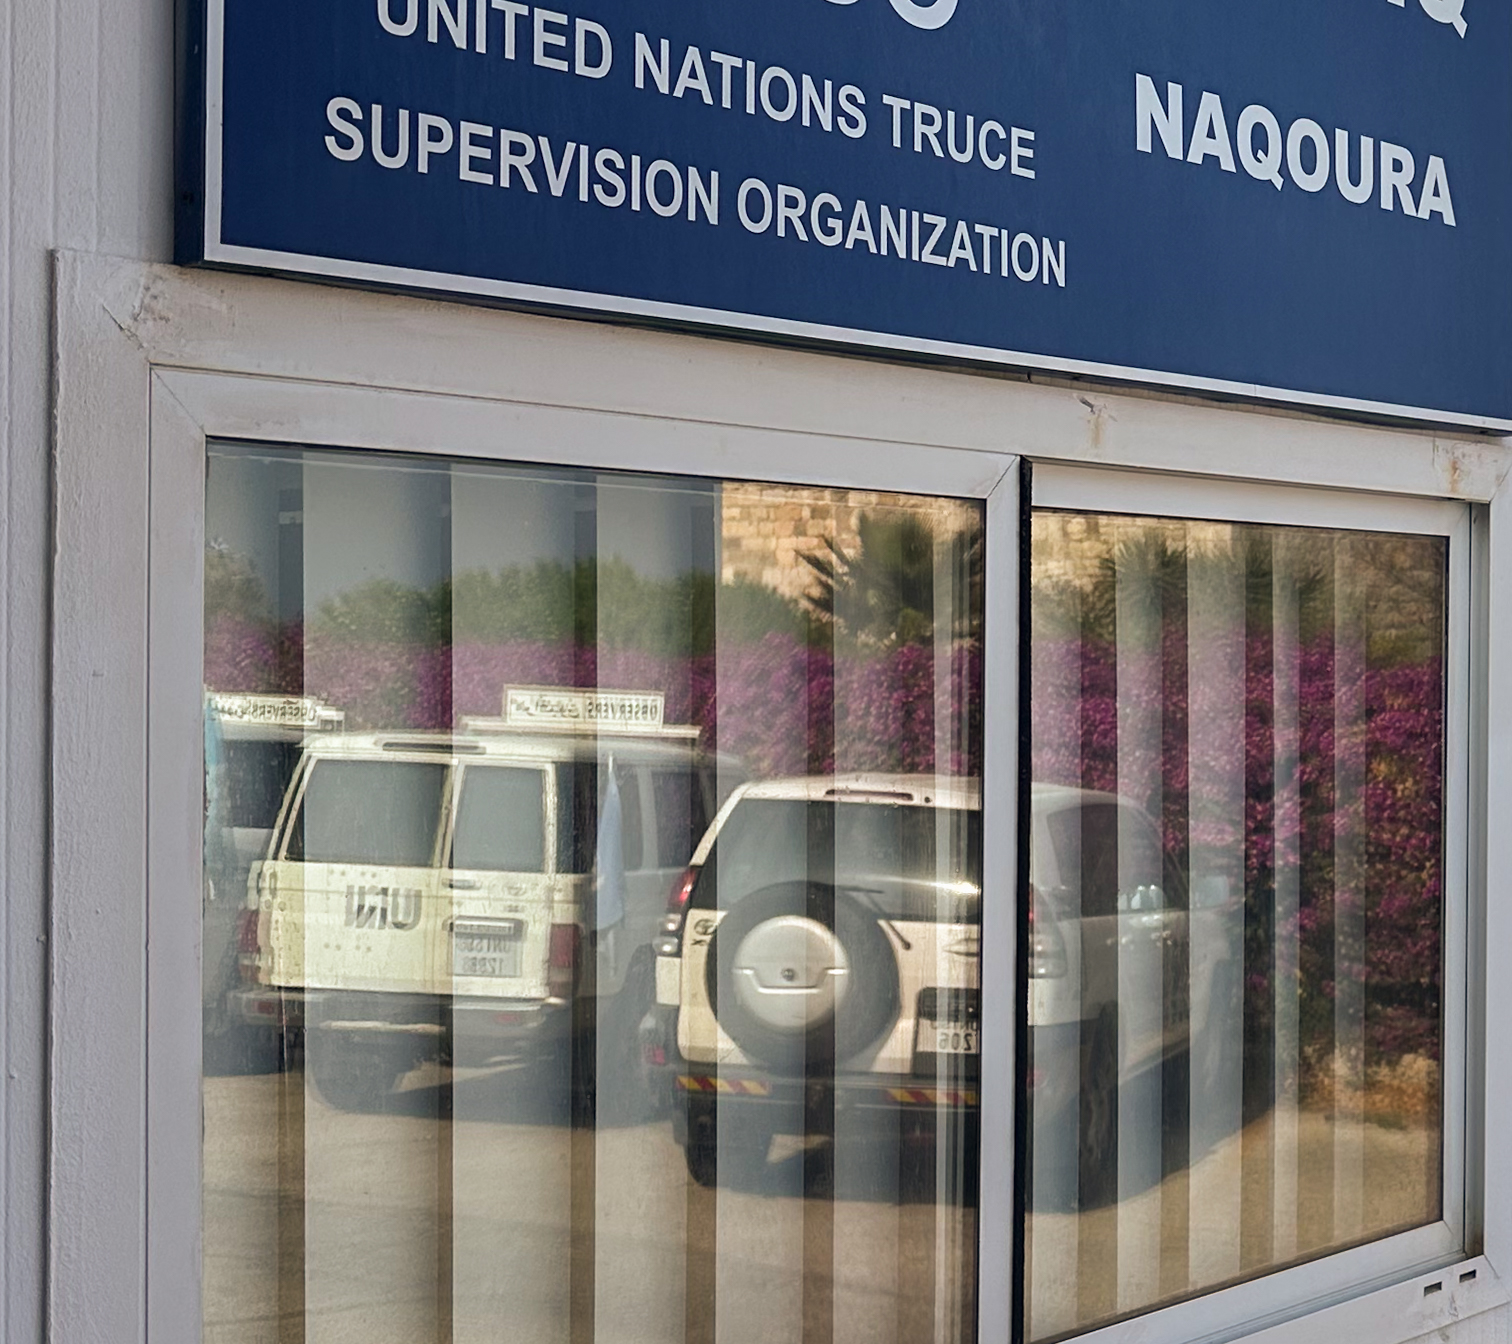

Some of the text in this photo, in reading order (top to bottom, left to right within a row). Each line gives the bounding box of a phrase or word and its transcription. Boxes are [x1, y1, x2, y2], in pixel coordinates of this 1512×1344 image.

[634, 32, 867, 139] NATIONS
[882, 93, 1036, 180] TRUCE
[1135, 72, 1457, 227] NAQOURA
[324, 97, 1066, 288] SUPERVISION ORGANIZATION
